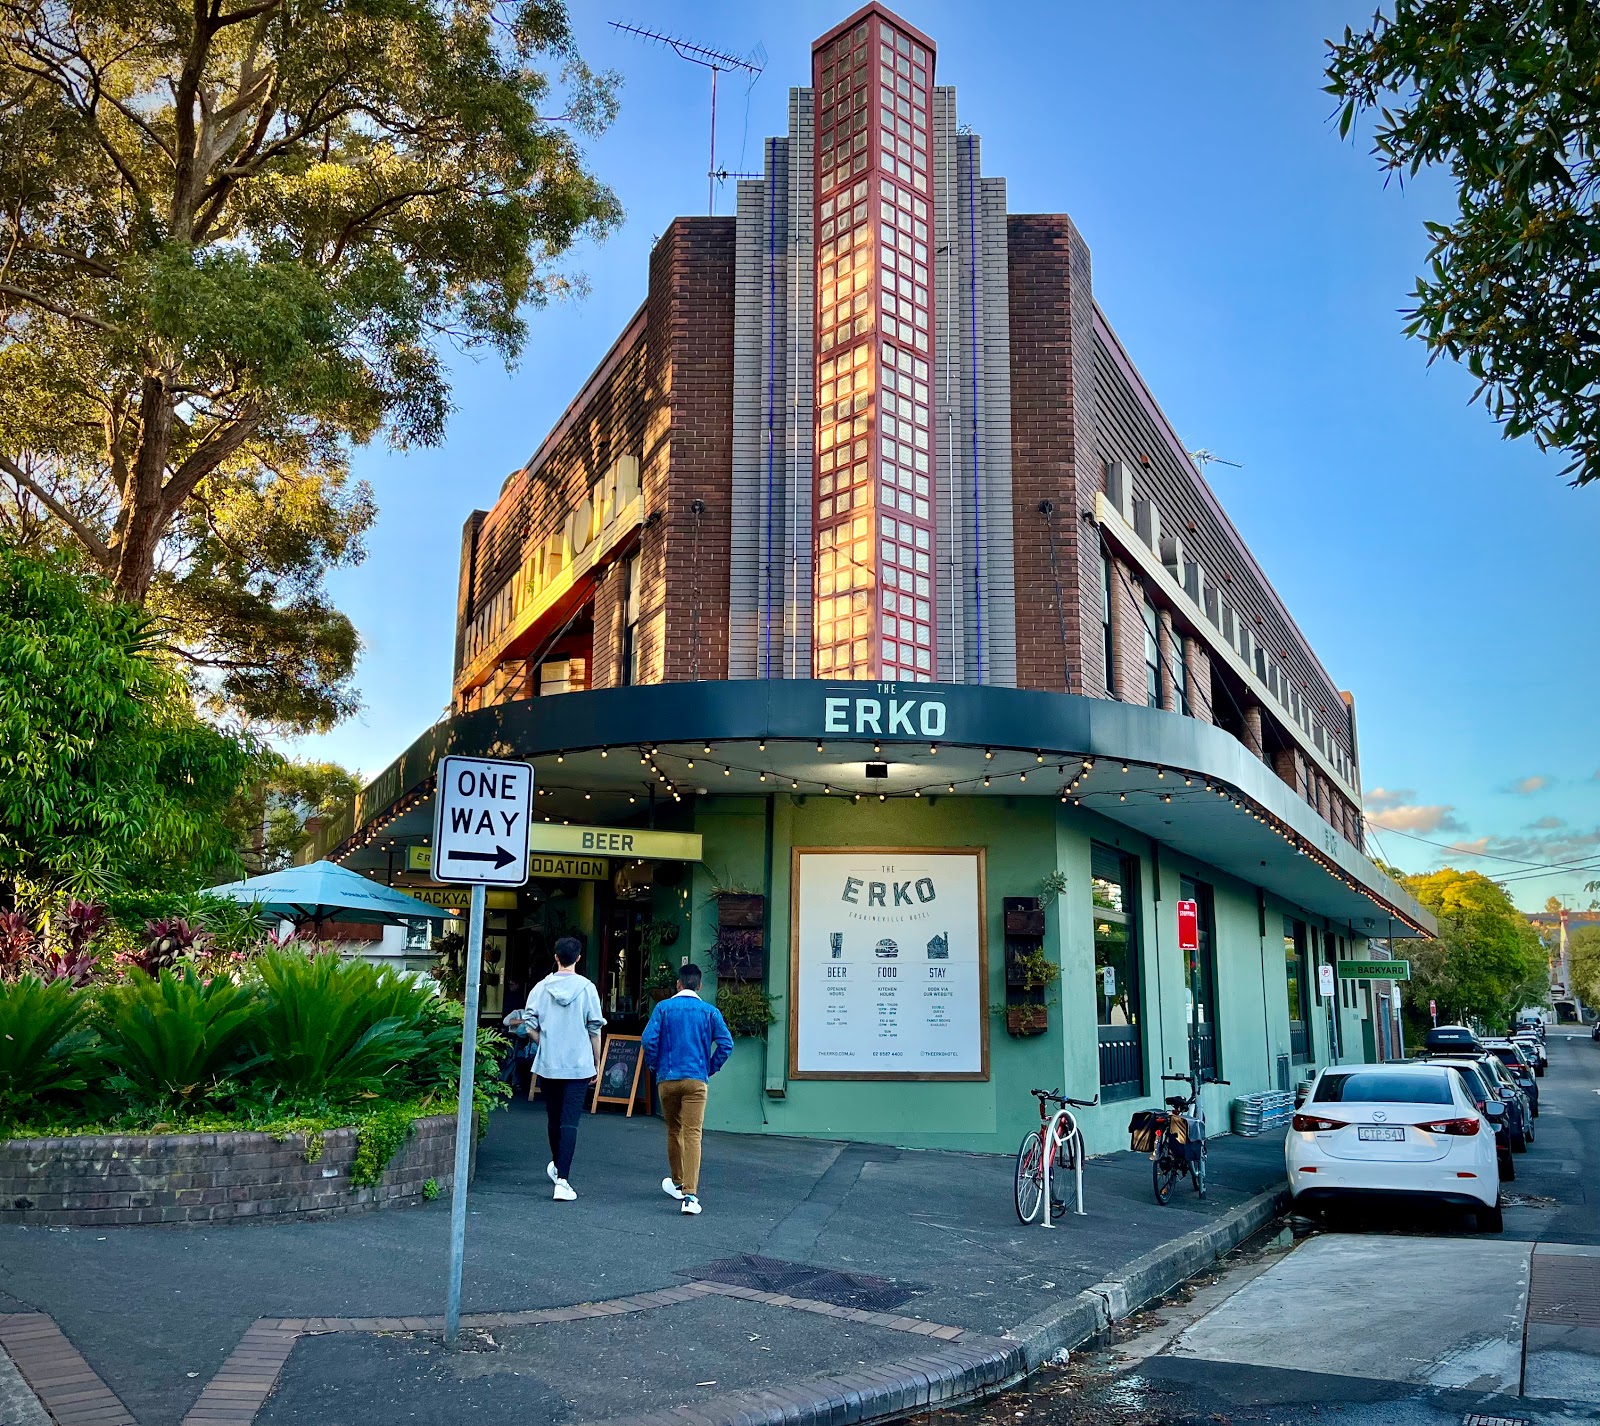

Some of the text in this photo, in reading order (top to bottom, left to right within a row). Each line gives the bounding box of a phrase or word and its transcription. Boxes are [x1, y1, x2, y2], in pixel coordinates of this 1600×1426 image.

[877, 684, 896, 694] THE
[825, 697, 947, 736] ERKO
[458, 770, 516, 800] ONE
[451, 807, 520, 837] WAY
[582, 832, 633, 851] BEER
[882, 865, 895, 873] THE
[842, 876, 936, 907] ERKO
[827, 966, 847, 977] BEER
[877, 966, 897, 977] FOOD
[929, 967, 946, 978] STAY
[1357, 966, 1404, 975] BACKYARD
